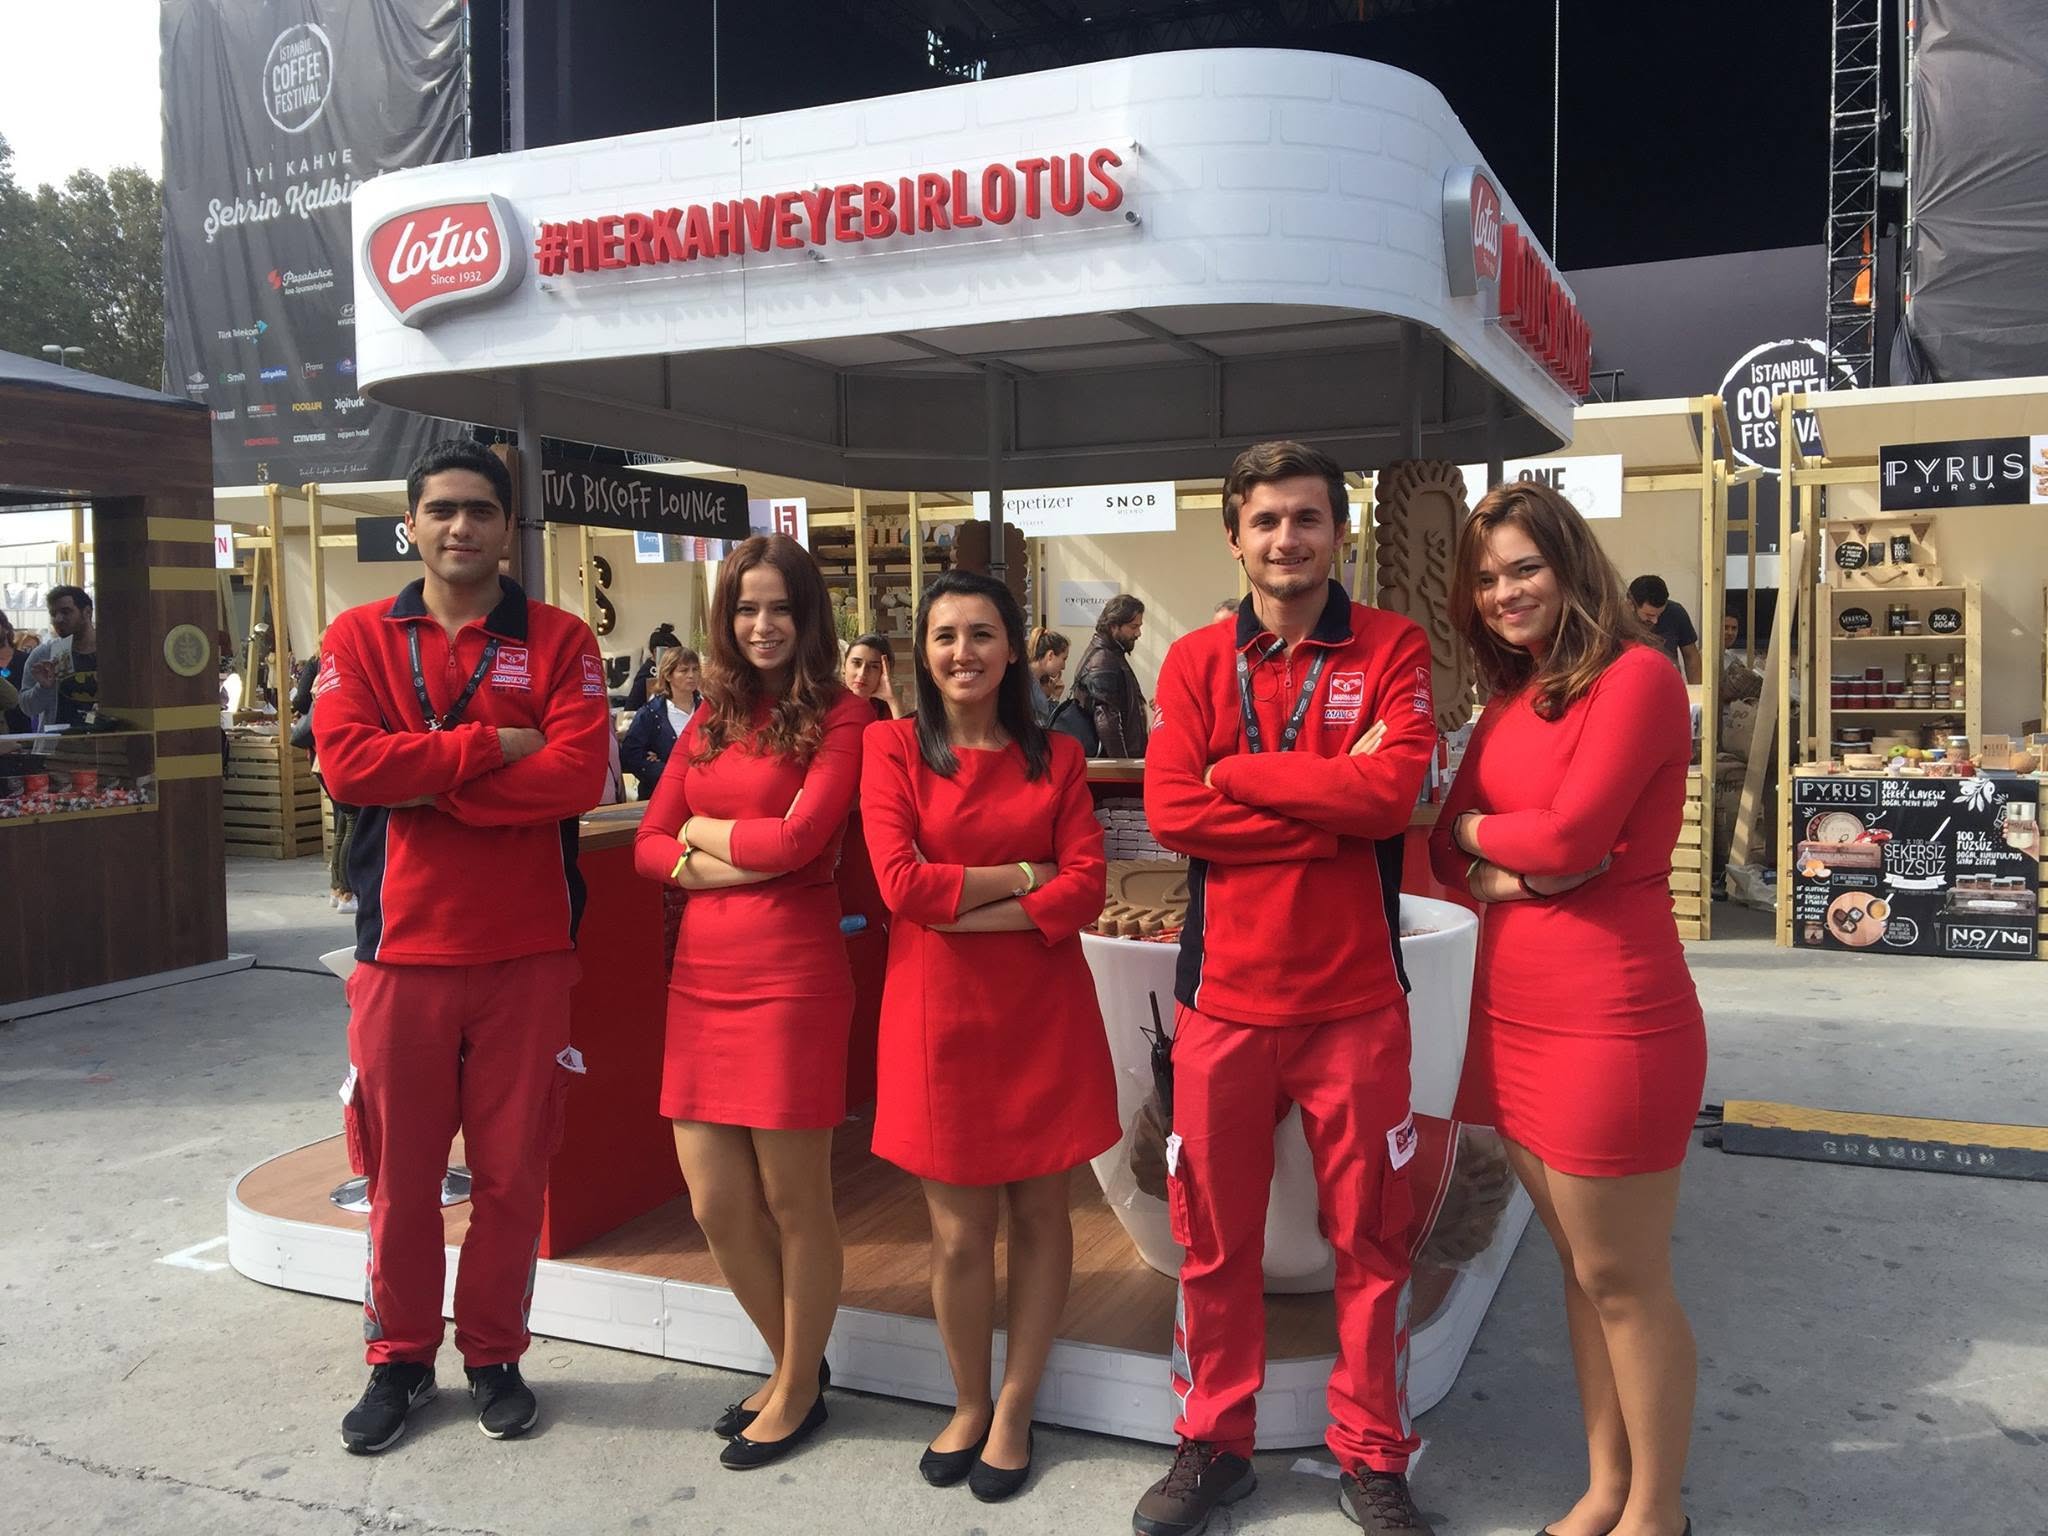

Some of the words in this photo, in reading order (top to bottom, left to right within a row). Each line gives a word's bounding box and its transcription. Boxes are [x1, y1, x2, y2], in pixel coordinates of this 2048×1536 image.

[273, 51, 321, 92] COFFEE
[275, 81, 321, 115] FESTIVAL
[247, 163, 272, 185] İYİ
[286, 148, 352, 176] KAHVE
[203, 192, 281, 243] Şehrin
[534, 147, 1124, 277] #HERKAHVEYEBIRLOTUS
[1475, 186, 1498, 257] Lotus
[388, 217, 489, 284] Lotus
[431, 273, 455, 285] Since
[459, 270, 482, 283] 1932
[1751, 358, 1818, 384] İSTANBUL
[1741, 415, 1822, 449] FESVA
[1886, 453, 2024, 486] PYRUS
[541, 469, 575, 510] TUS
[582, 473, 651, 520] BISCOFF
[660, 485, 727, 525] LOUNGE
[1002, 495, 1074, 515] epetizer
[1106, 494, 1156, 508] SNOB
[1914, 482, 1995, 494] BURSA
[1065, 597, 1108, 605] eyepetize
[1802, 783, 1872, 797] PYRUS
[1882, 781, 1898, 790] 100
[1956, 831, 1974, 841] 100
[1885, 859, 1946, 875] TUZSUZ
